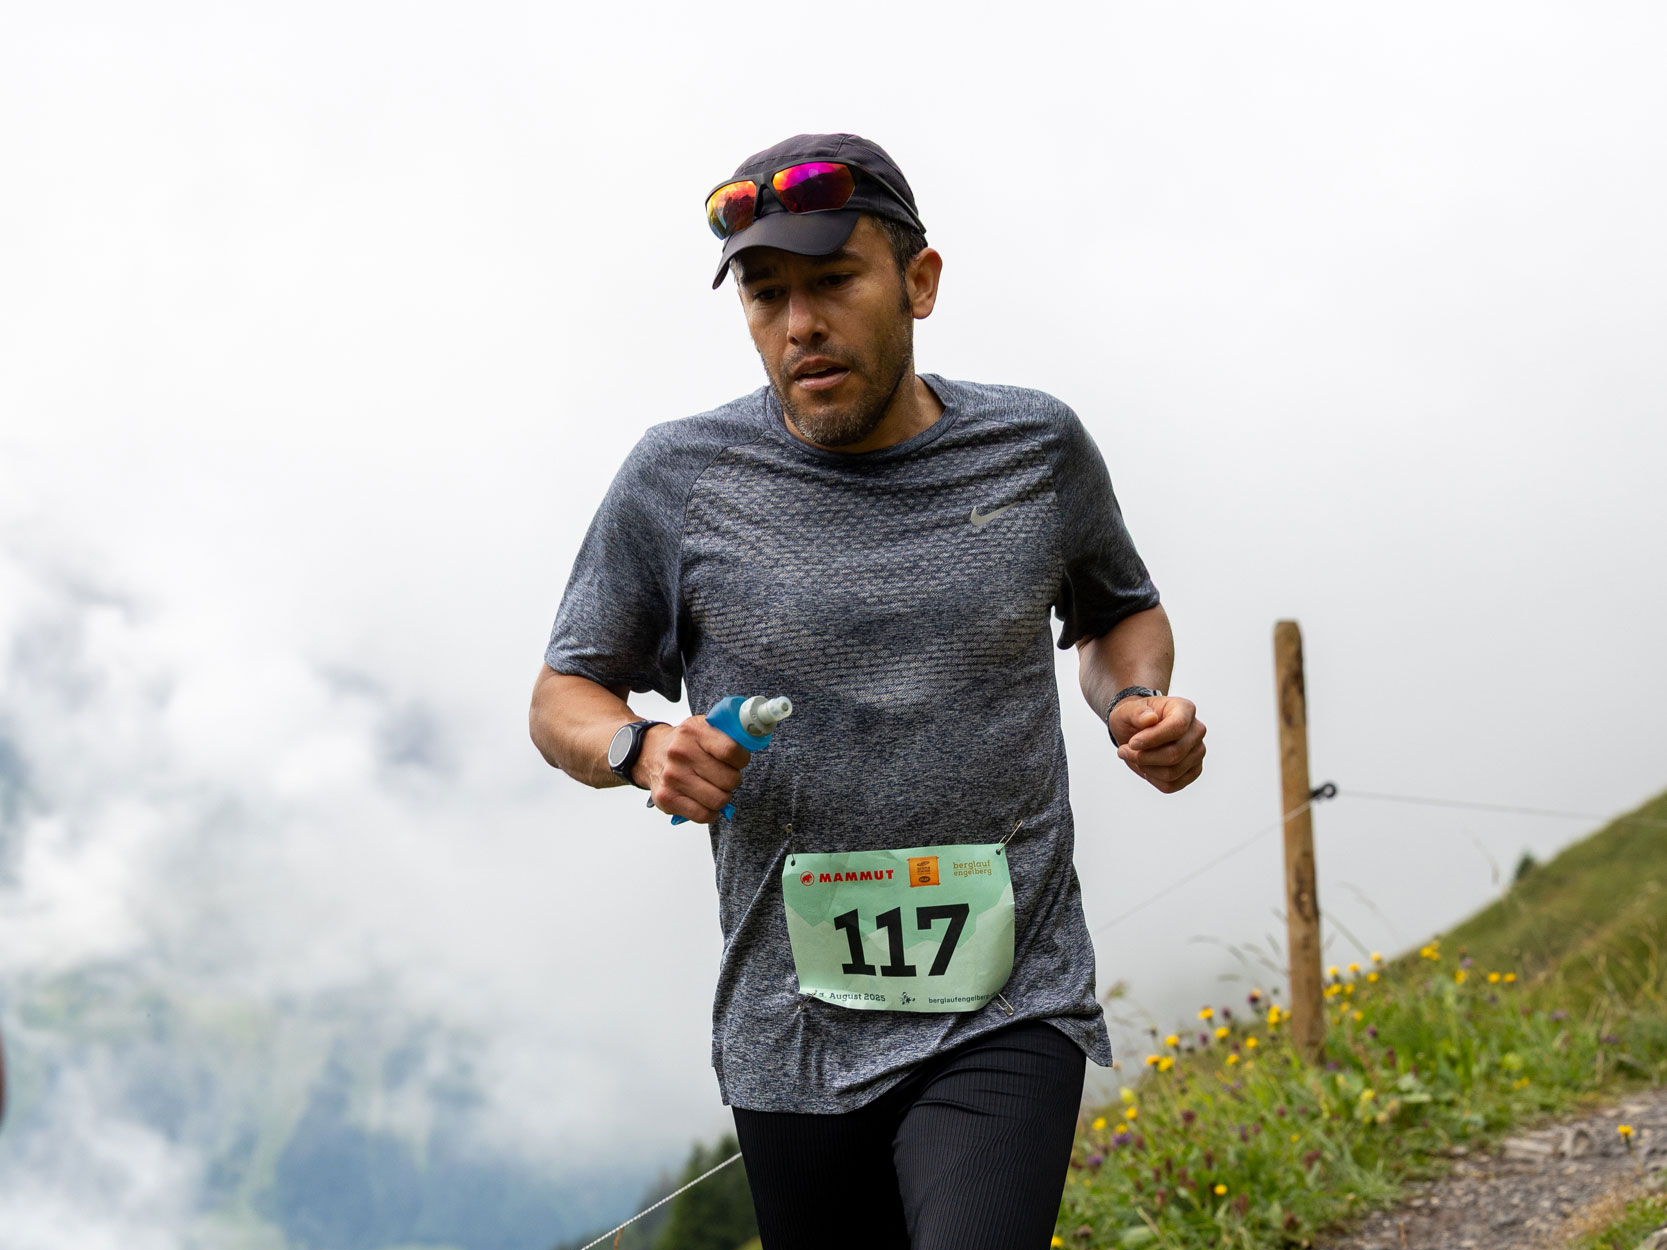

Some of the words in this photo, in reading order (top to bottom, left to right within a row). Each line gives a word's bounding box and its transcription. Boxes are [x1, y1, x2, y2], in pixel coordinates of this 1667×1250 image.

[953, 860, 990, 869] berglauf
[819, 869, 894, 883] MAMMUT
[953, 868, 992, 877] engelberg
[833, 903, 970, 977] 117
[829, 992, 861, 1001] August
[863, 993, 886, 1002] 2025
